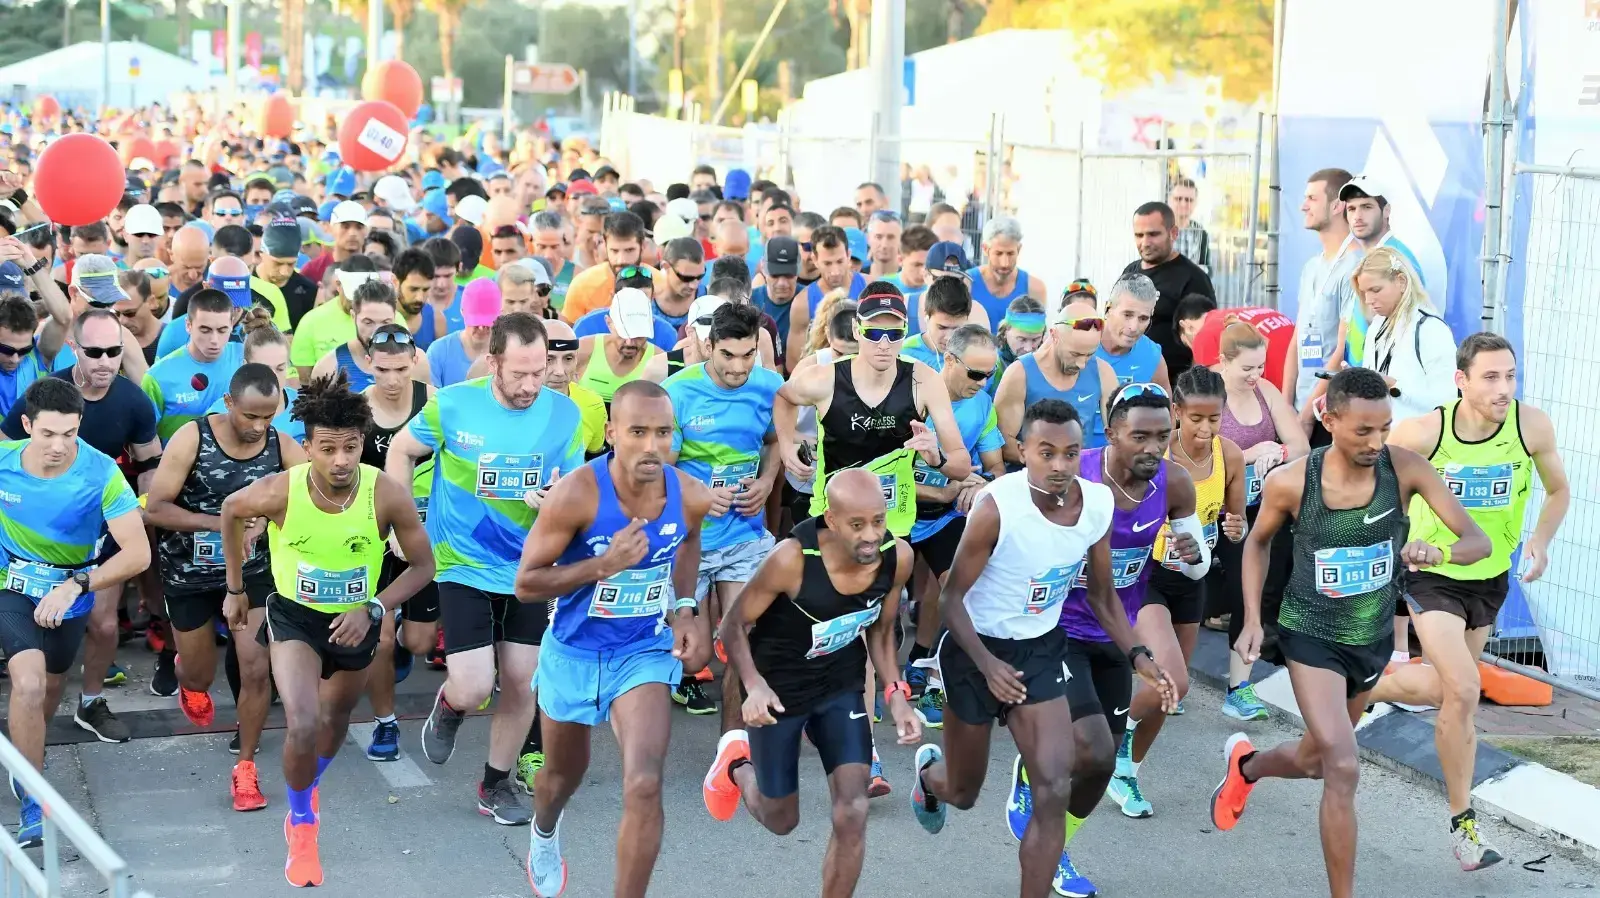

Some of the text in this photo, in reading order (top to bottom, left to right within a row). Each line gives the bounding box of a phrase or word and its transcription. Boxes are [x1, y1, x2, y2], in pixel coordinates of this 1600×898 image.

[456, 430, 469, 443] 21
[501, 476, 520, 487] 360
[930, 478, 941, 486] 44
[1469, 486, 1488, 497] 133
[1345, 569, 1365, 582] 151
[31, 587, 44, 598] 98
[322, 587, 342, 595] 715
[621, 592, 642, 603] 716
